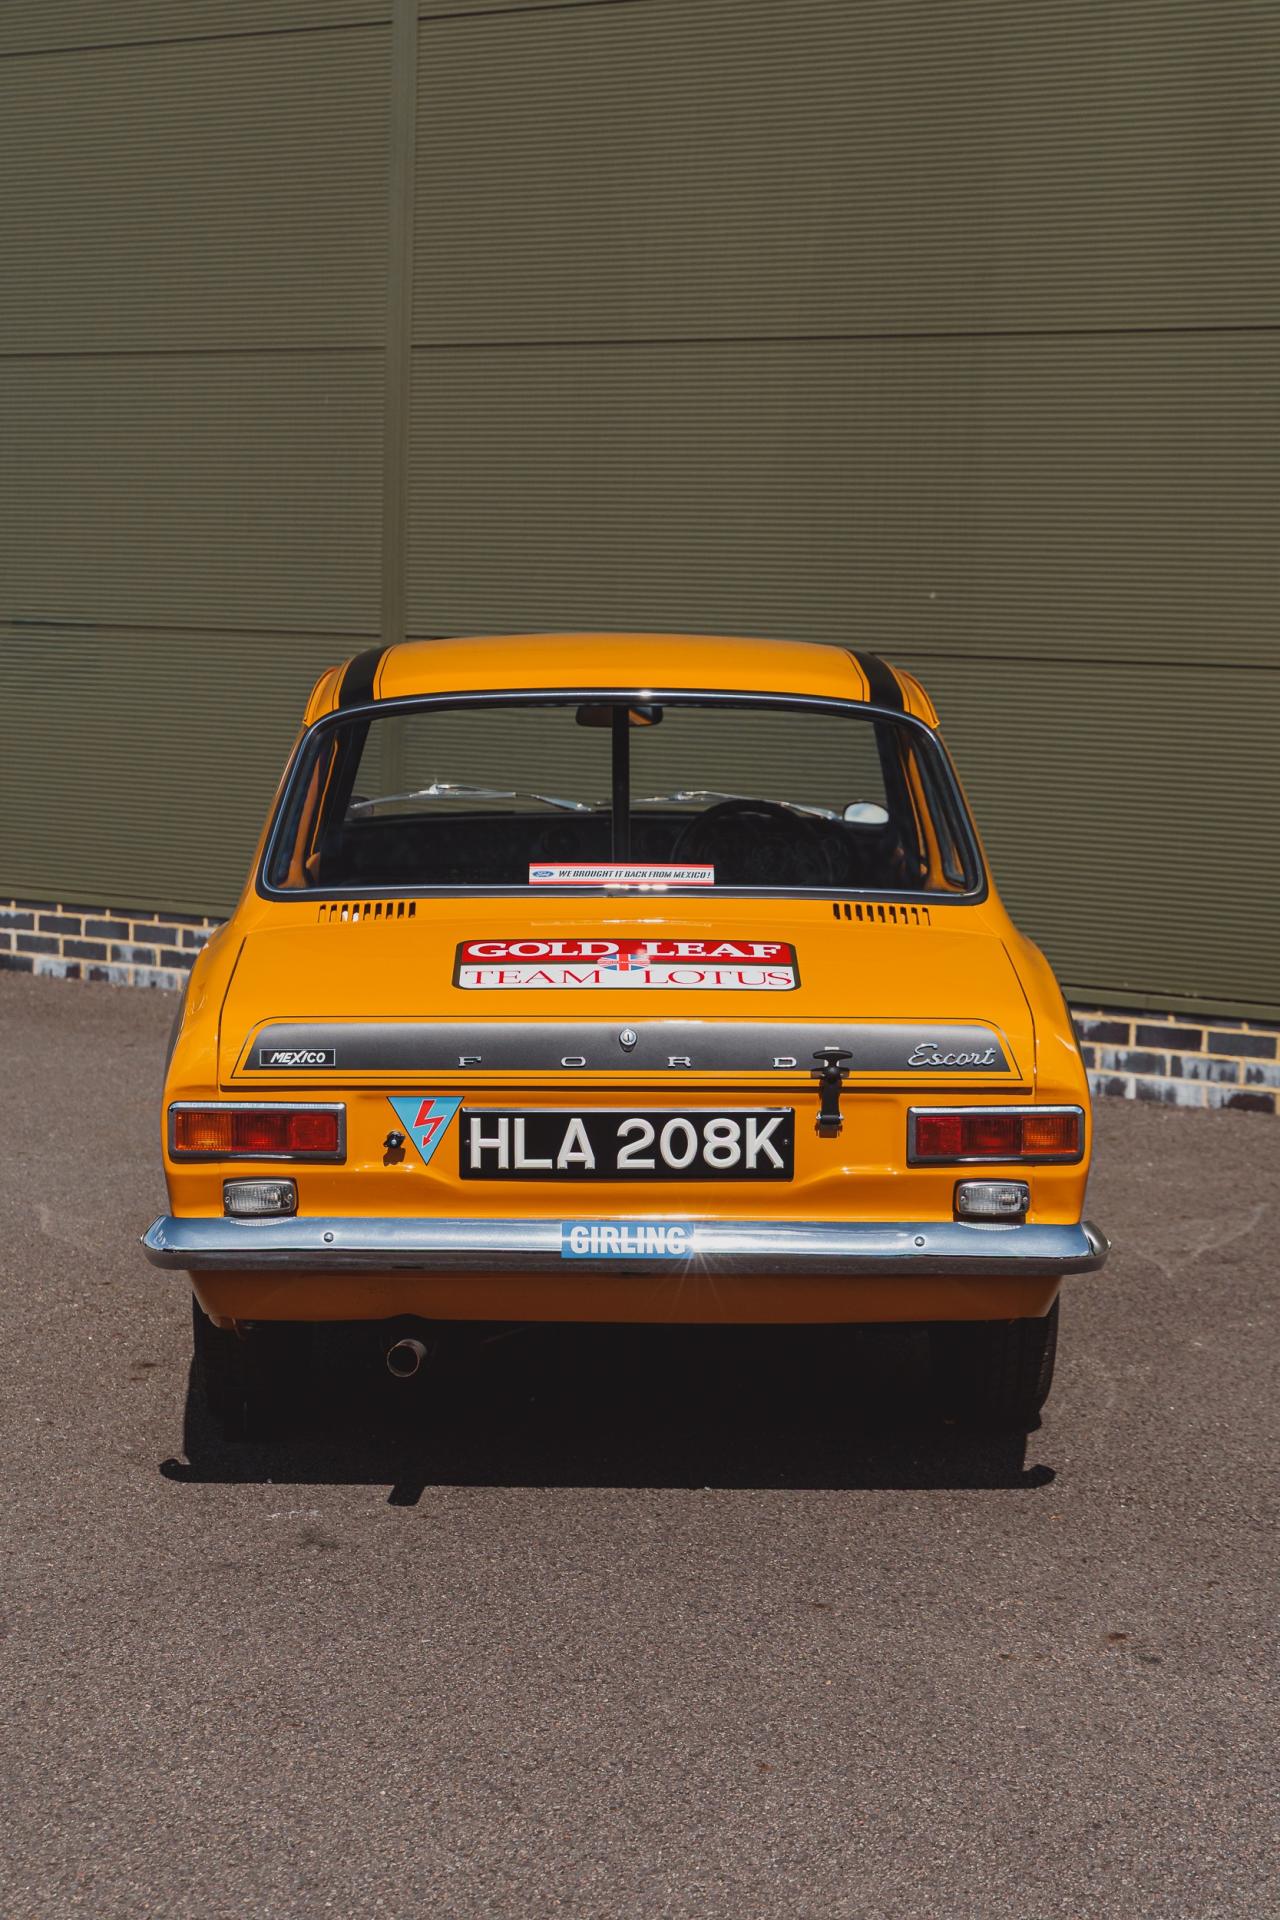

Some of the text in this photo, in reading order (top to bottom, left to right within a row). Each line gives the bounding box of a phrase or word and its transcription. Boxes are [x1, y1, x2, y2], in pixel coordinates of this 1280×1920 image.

[558, 870, 571, 878] WE
[572, 870, 614, 878] BROUGHT
[614, 870, 622, 878] IT
[624, 870, 647, 878] BACK
[467, 942, 781, 958] GOLD LEAF
[465, 970, 792, 985] TEAM LOTUS
[269, 1050, 326, 1065] MEXICO
[907, 1043, 997, 1067] Escort
[470, 1118, 785, 1170] HLA 208K
[570, 1226, 687, 1254] GIRLING
